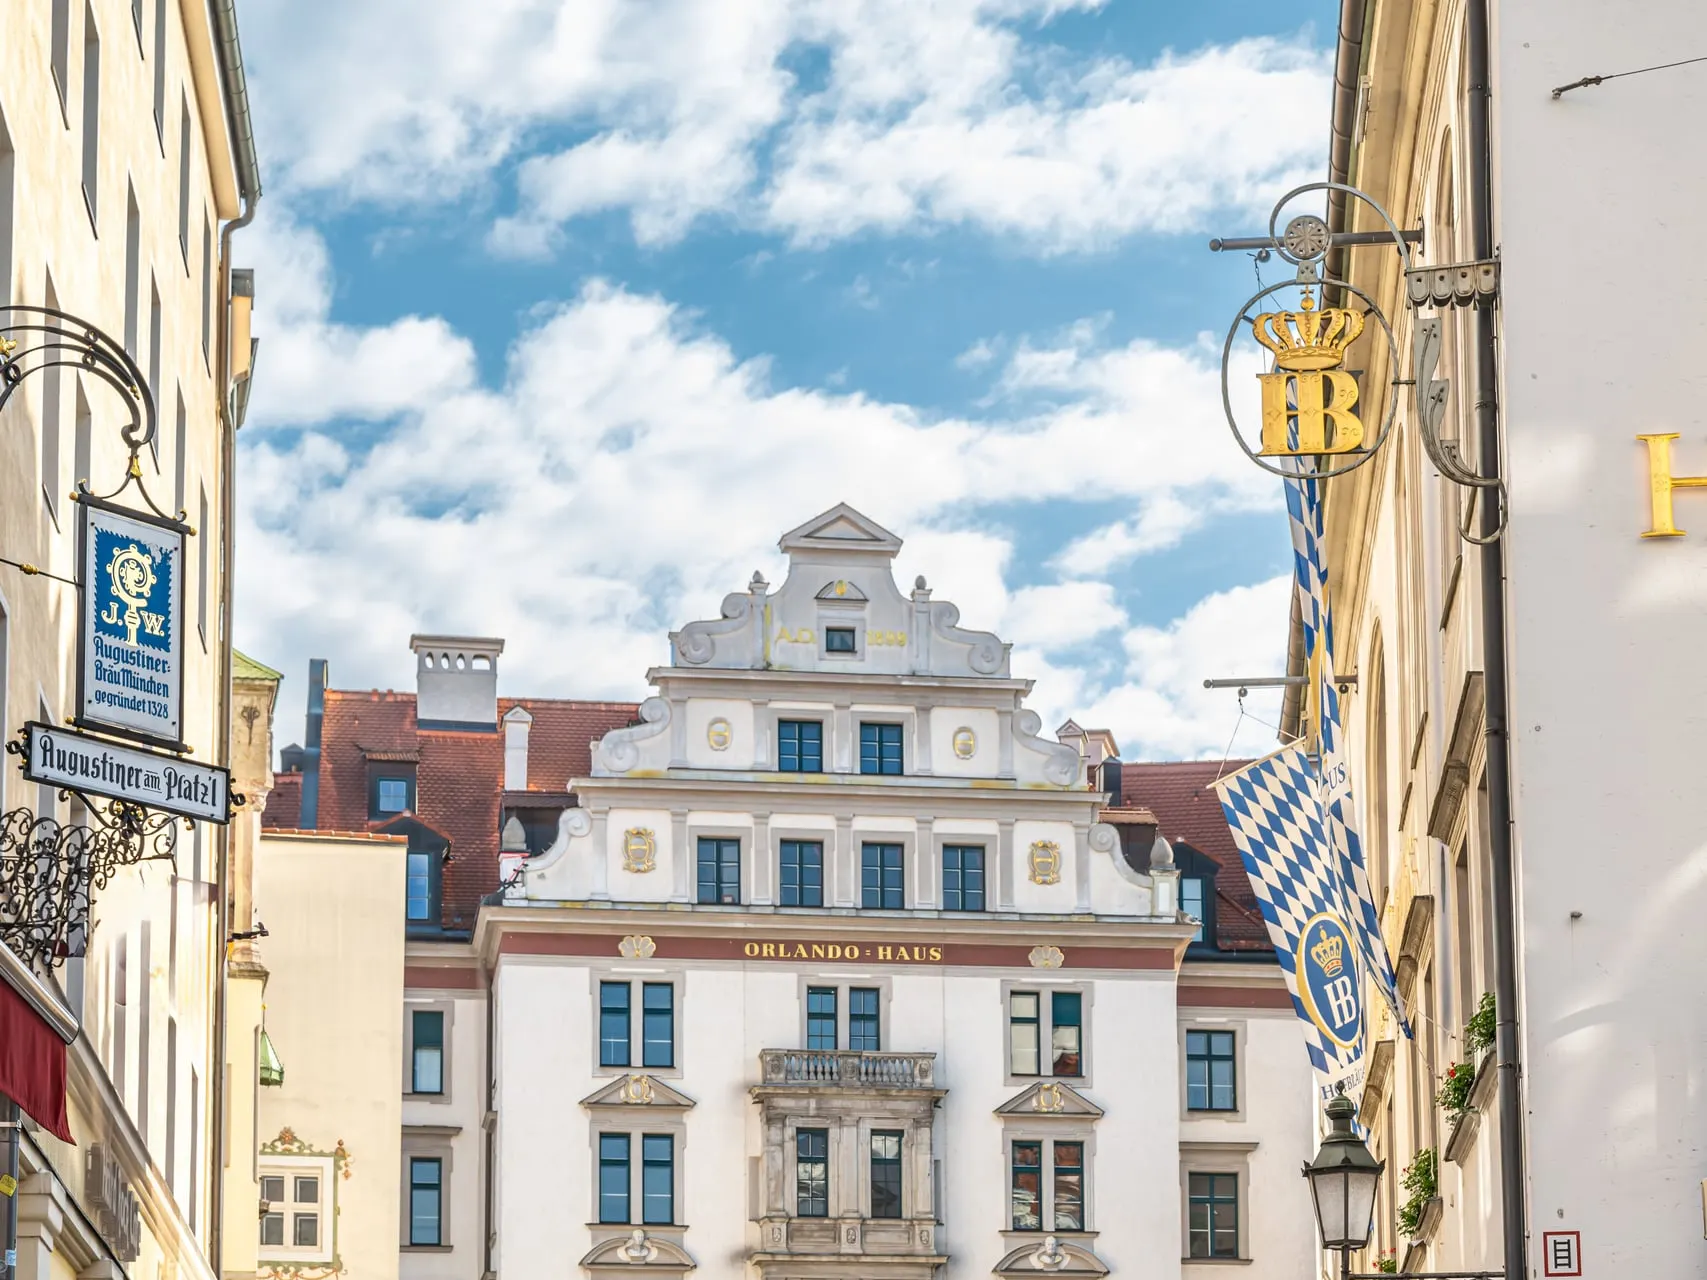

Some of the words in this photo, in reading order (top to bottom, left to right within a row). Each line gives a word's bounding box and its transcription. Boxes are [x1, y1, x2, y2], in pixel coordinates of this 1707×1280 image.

[95, 689, 147, 713] gegründet
[148, 700, 169, 719] 1328
[39, 734, 143, 791] Augustiner
[143, 772, 161, 791] am
